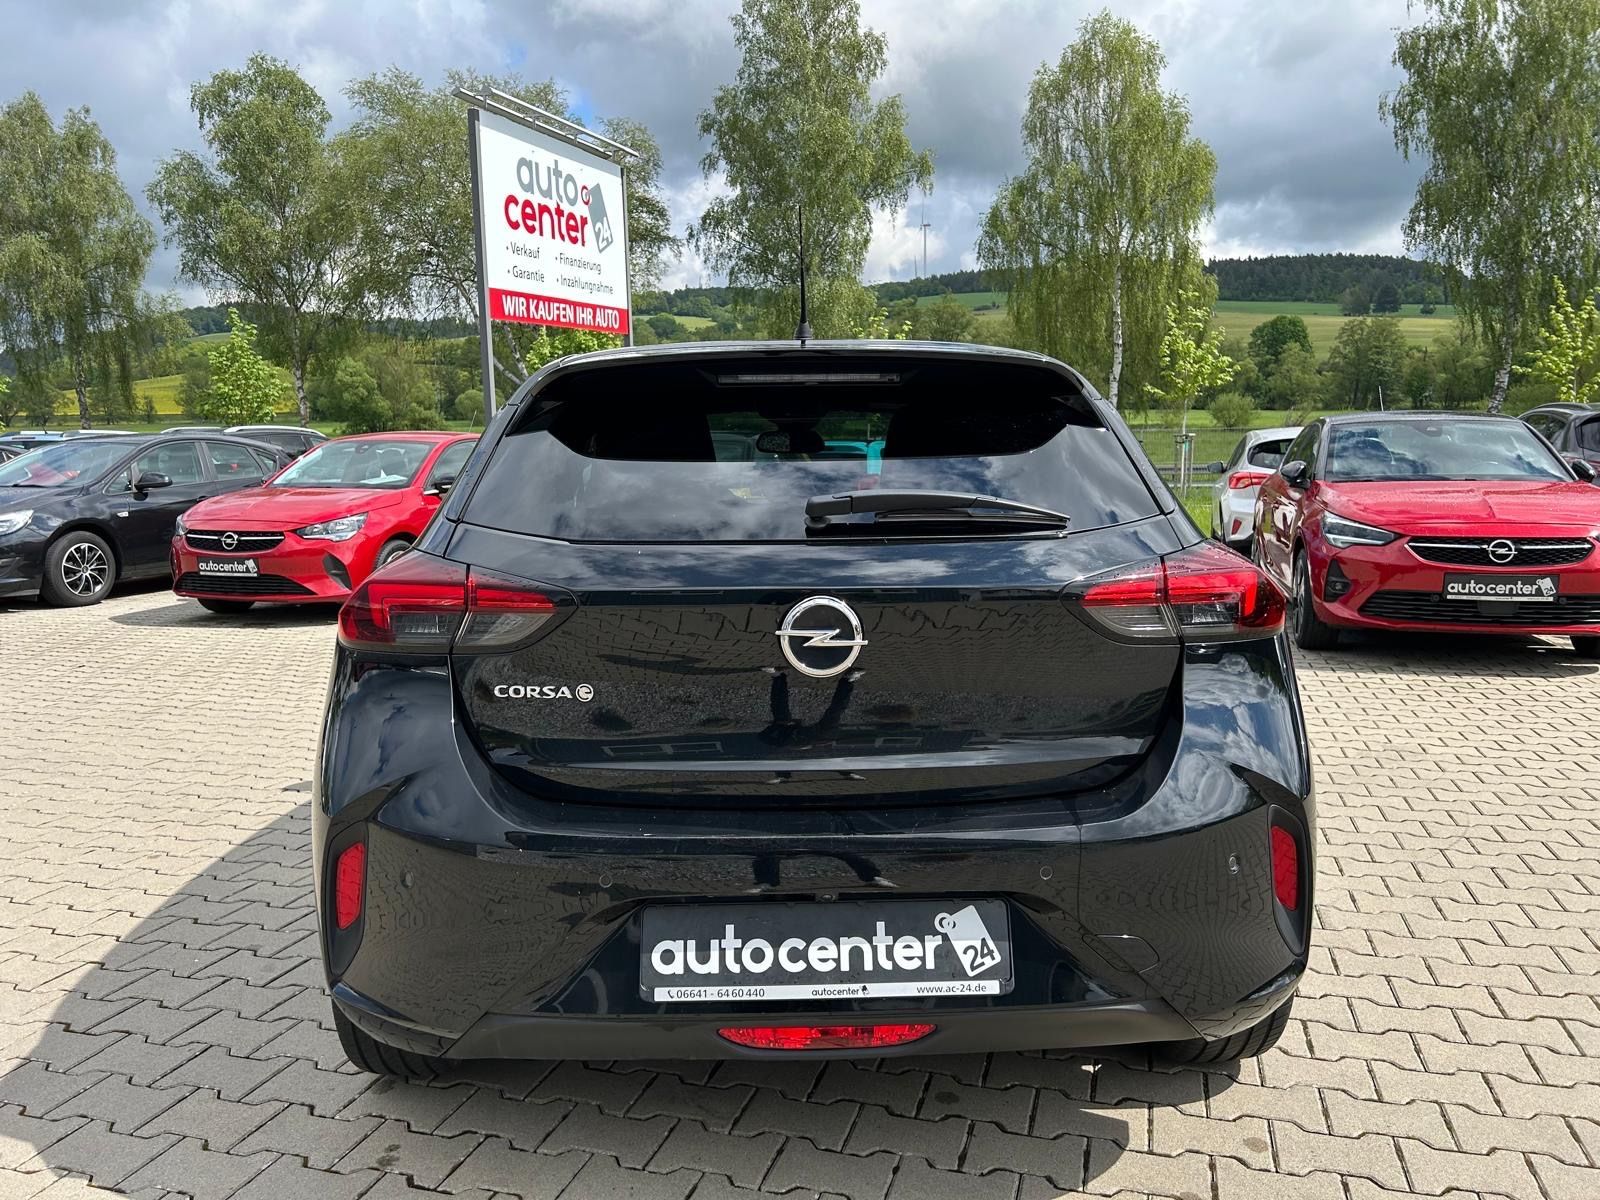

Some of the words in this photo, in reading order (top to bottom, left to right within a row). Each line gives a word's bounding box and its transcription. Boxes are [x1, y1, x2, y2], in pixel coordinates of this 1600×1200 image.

[517, 156, 578, 207] auto
[504, 194, 588, 247] center
[594, 216, 612, 247] 24
[511, 241, 540, 259] Verkauf
[559, 253, 601, 275] Finanzierung
[512, 265, 545, 283] Garantie
[560, 274, 614, 295] Inzahlungnahme
[502, 295, 527, 318] WIR
[529, 299, 574, 324] KAUFEN
[575, 306, 594, 327] IHR
[595, 309, 620, 330] AUTO
[199, 560, 247, 571] autocenter
[1447, 579, 1538, 594] autocenter
[494, 685, 573, 699] CORSA
[651, 921, 942, 975] autocenter
[962, 937, 996, 973] 24
[676, 989, 708, 999] 06641
[811, 987, 860, 997] autocenter
[916, 984, 987, 994] www.ac-24.de
